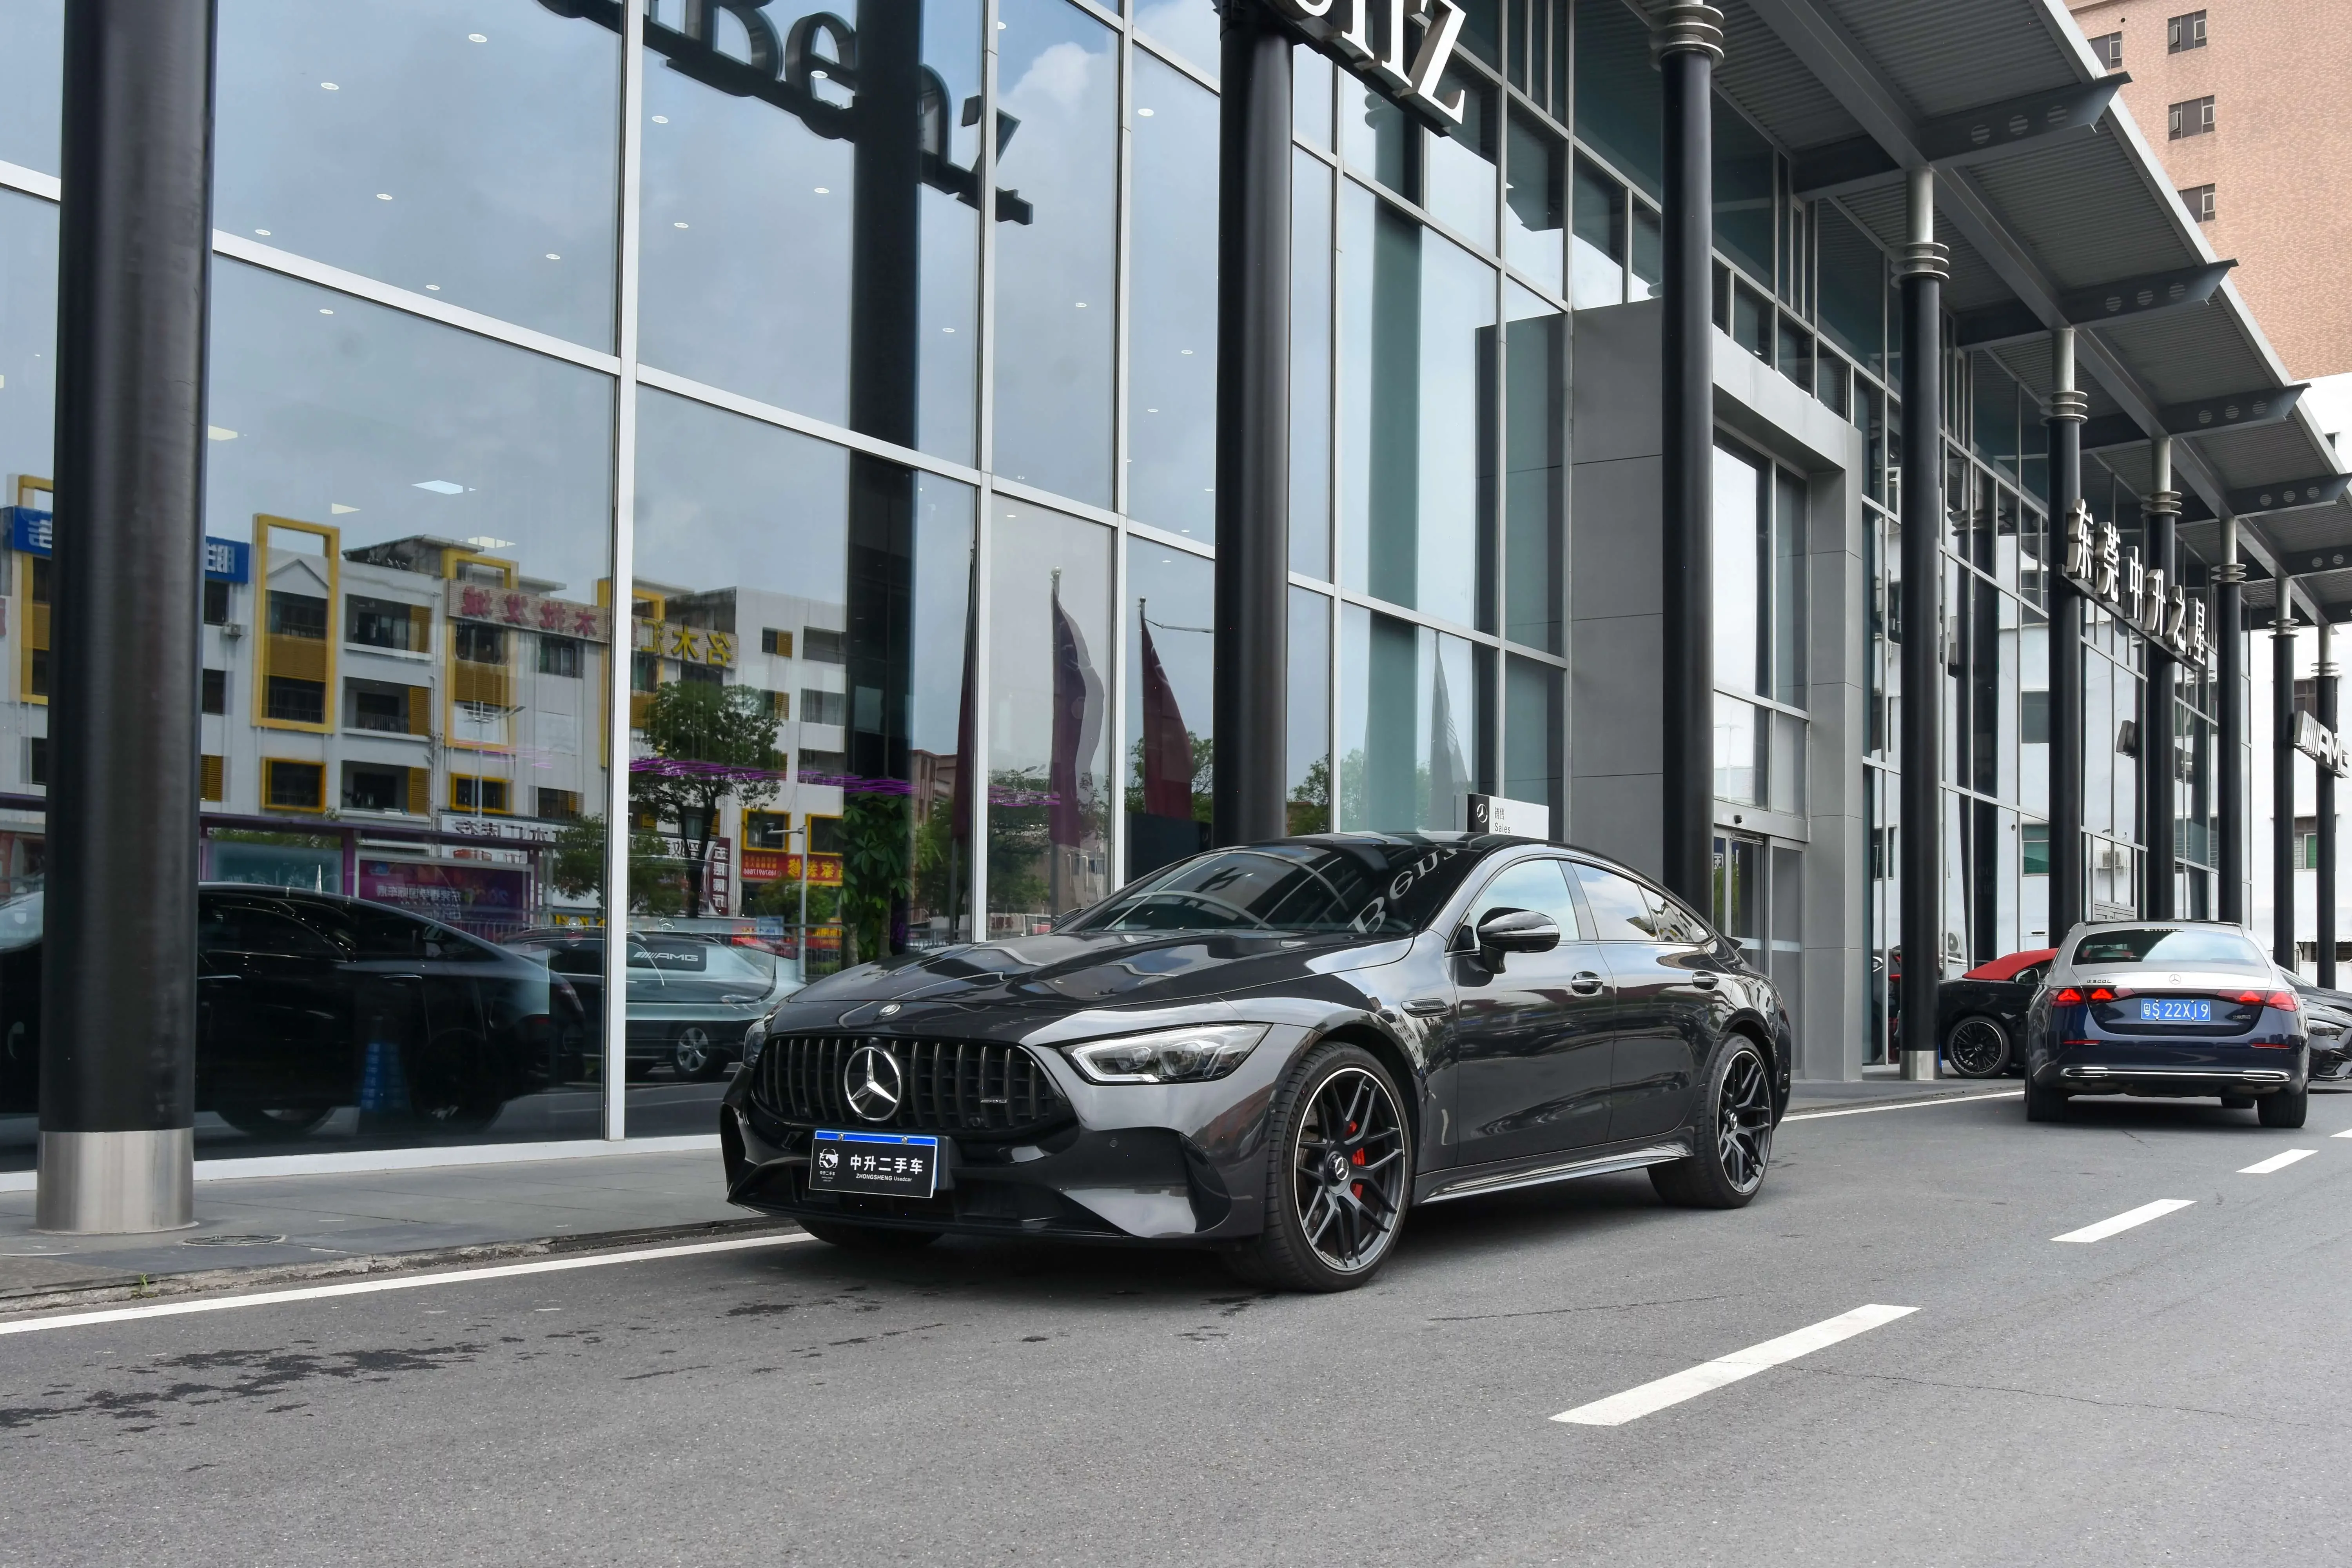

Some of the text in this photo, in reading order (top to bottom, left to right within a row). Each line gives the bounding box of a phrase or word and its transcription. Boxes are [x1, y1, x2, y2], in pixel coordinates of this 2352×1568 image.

[1298, 0, 1466, 125] nz
[2075, 498, 2206, 666] 东莞中升之星
[1495, 806, 1504, 820] 销售
[1495, 822, 1511, 834] Sales
[654, 952, 698, 962] AMG
[850, 1154, 923, 1175] 中升二手车
[856, 1173, 893, 1181] ZHONGSHENG
